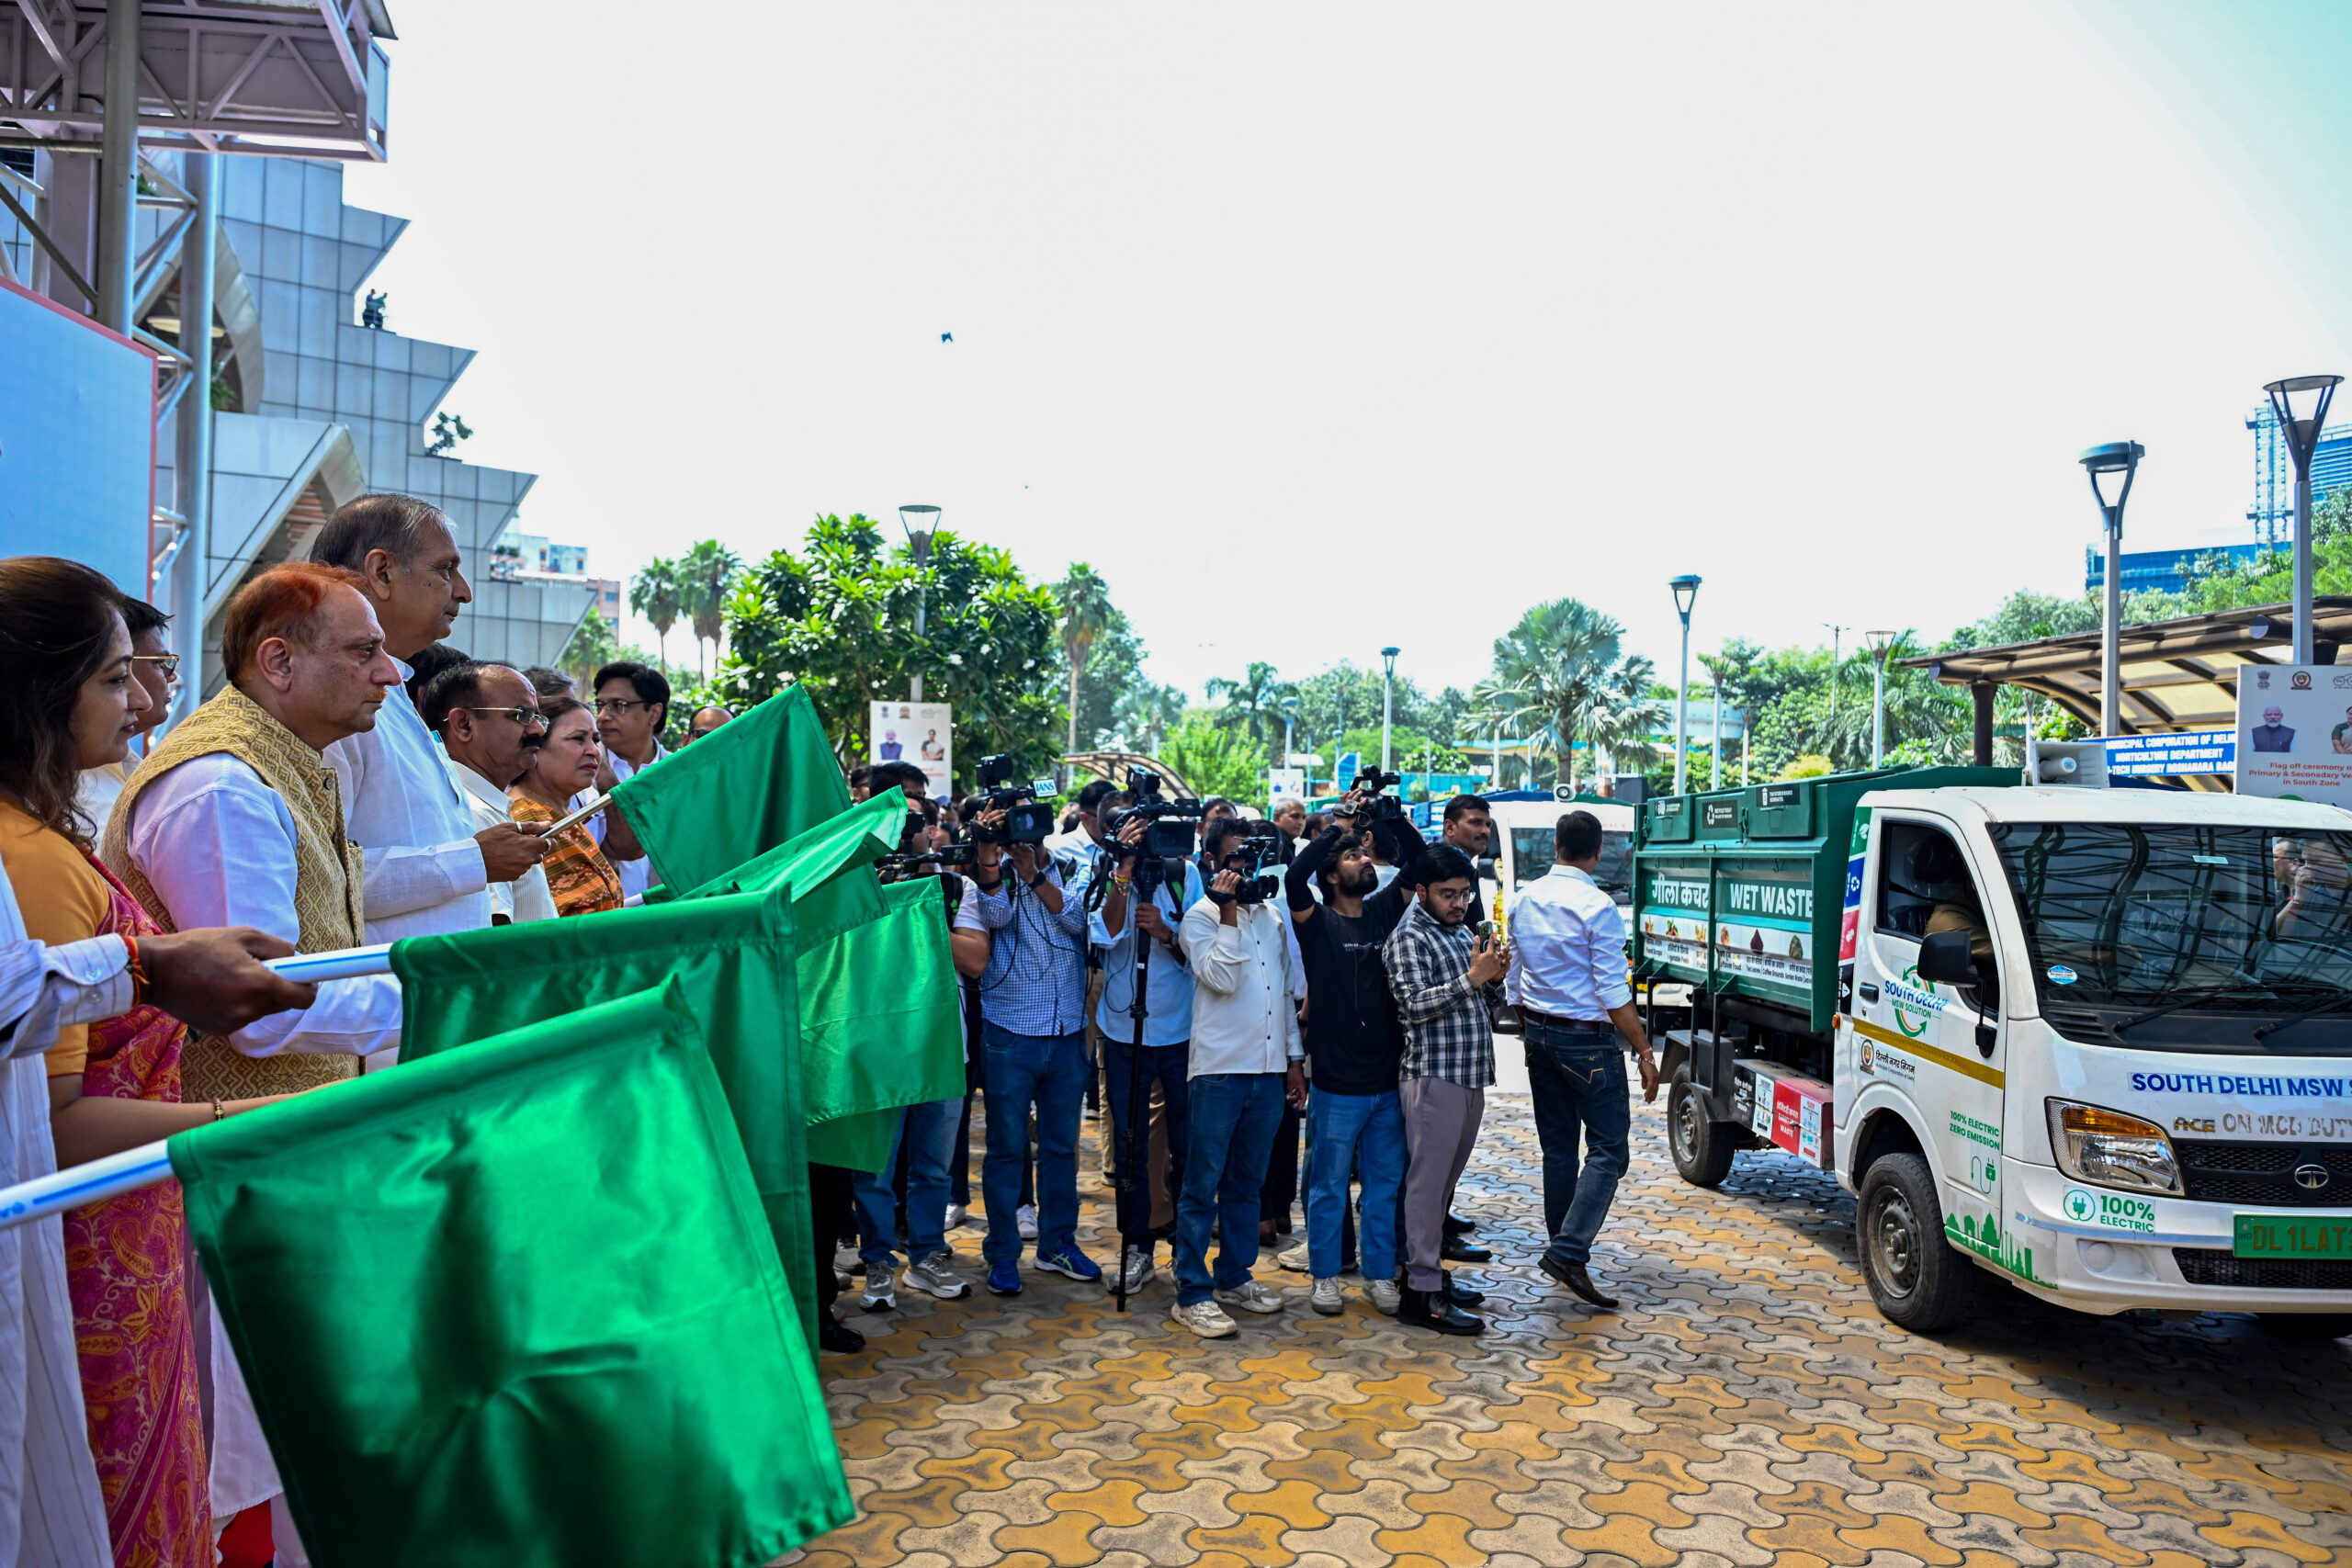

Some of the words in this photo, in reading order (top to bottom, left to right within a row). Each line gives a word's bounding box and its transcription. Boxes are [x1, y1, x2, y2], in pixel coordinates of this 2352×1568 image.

[2145, 735, 2199, 748] CORPORATION
[2200, 735, 2211, 744] OF
[2115, 750, 2168, 762] HORTICULTURE
[2170, 748, 2223, 760] DEPARTMENT
[2249, 770, 2281, 778] Primary
[2291, 772, 2339, 780] Seconadary
[2270, 762, 2288, 771] Flag
[2303, 764, 2344, 773] ceremony
[1035, 782, 1055, 792] IANS
[1652, 872, 1680, 905] गीला
[1730, 883, 1759, 911] WET
[1761, 886, 1813, 918] WASTE
[1885, 980, 1915, 1002] SOUTH
[1916, 992, 1949, 1011] DELHI
[1892, 998, 1904, 1009] MSW
[1905, 1004, 1931, 1019] SOLUTION
[1876, 1050, 1888, 1064] दिल्ली
[1889, 1057, 1900, 1068] नगर
[1901, 1059, 1915, 1074] निगम
[2132, 1073, 2212, 1093] SOUTH
[2219, 1077, 2282, 1095] DELHI
[2287, 1078, 2343, 1096] MSW
[1951, 1110, 1967, 1125] 100%
[1968, 1118, 1999, 1137] ELECTRIC
[2174, 1116, 2215, 1133] ACE
[2222, 1112, 2251, 1134] ON
[1950, 1122, 1966, 1136] ZERO
[1967, 1130, 2000, 1151] EMISSION
[2100, 1194, 2154, 1221] 100%
[2100, 1214, 2154, 1233] ELECTRIC
[2253, 1224, 2352, 1252] DL1LAT
